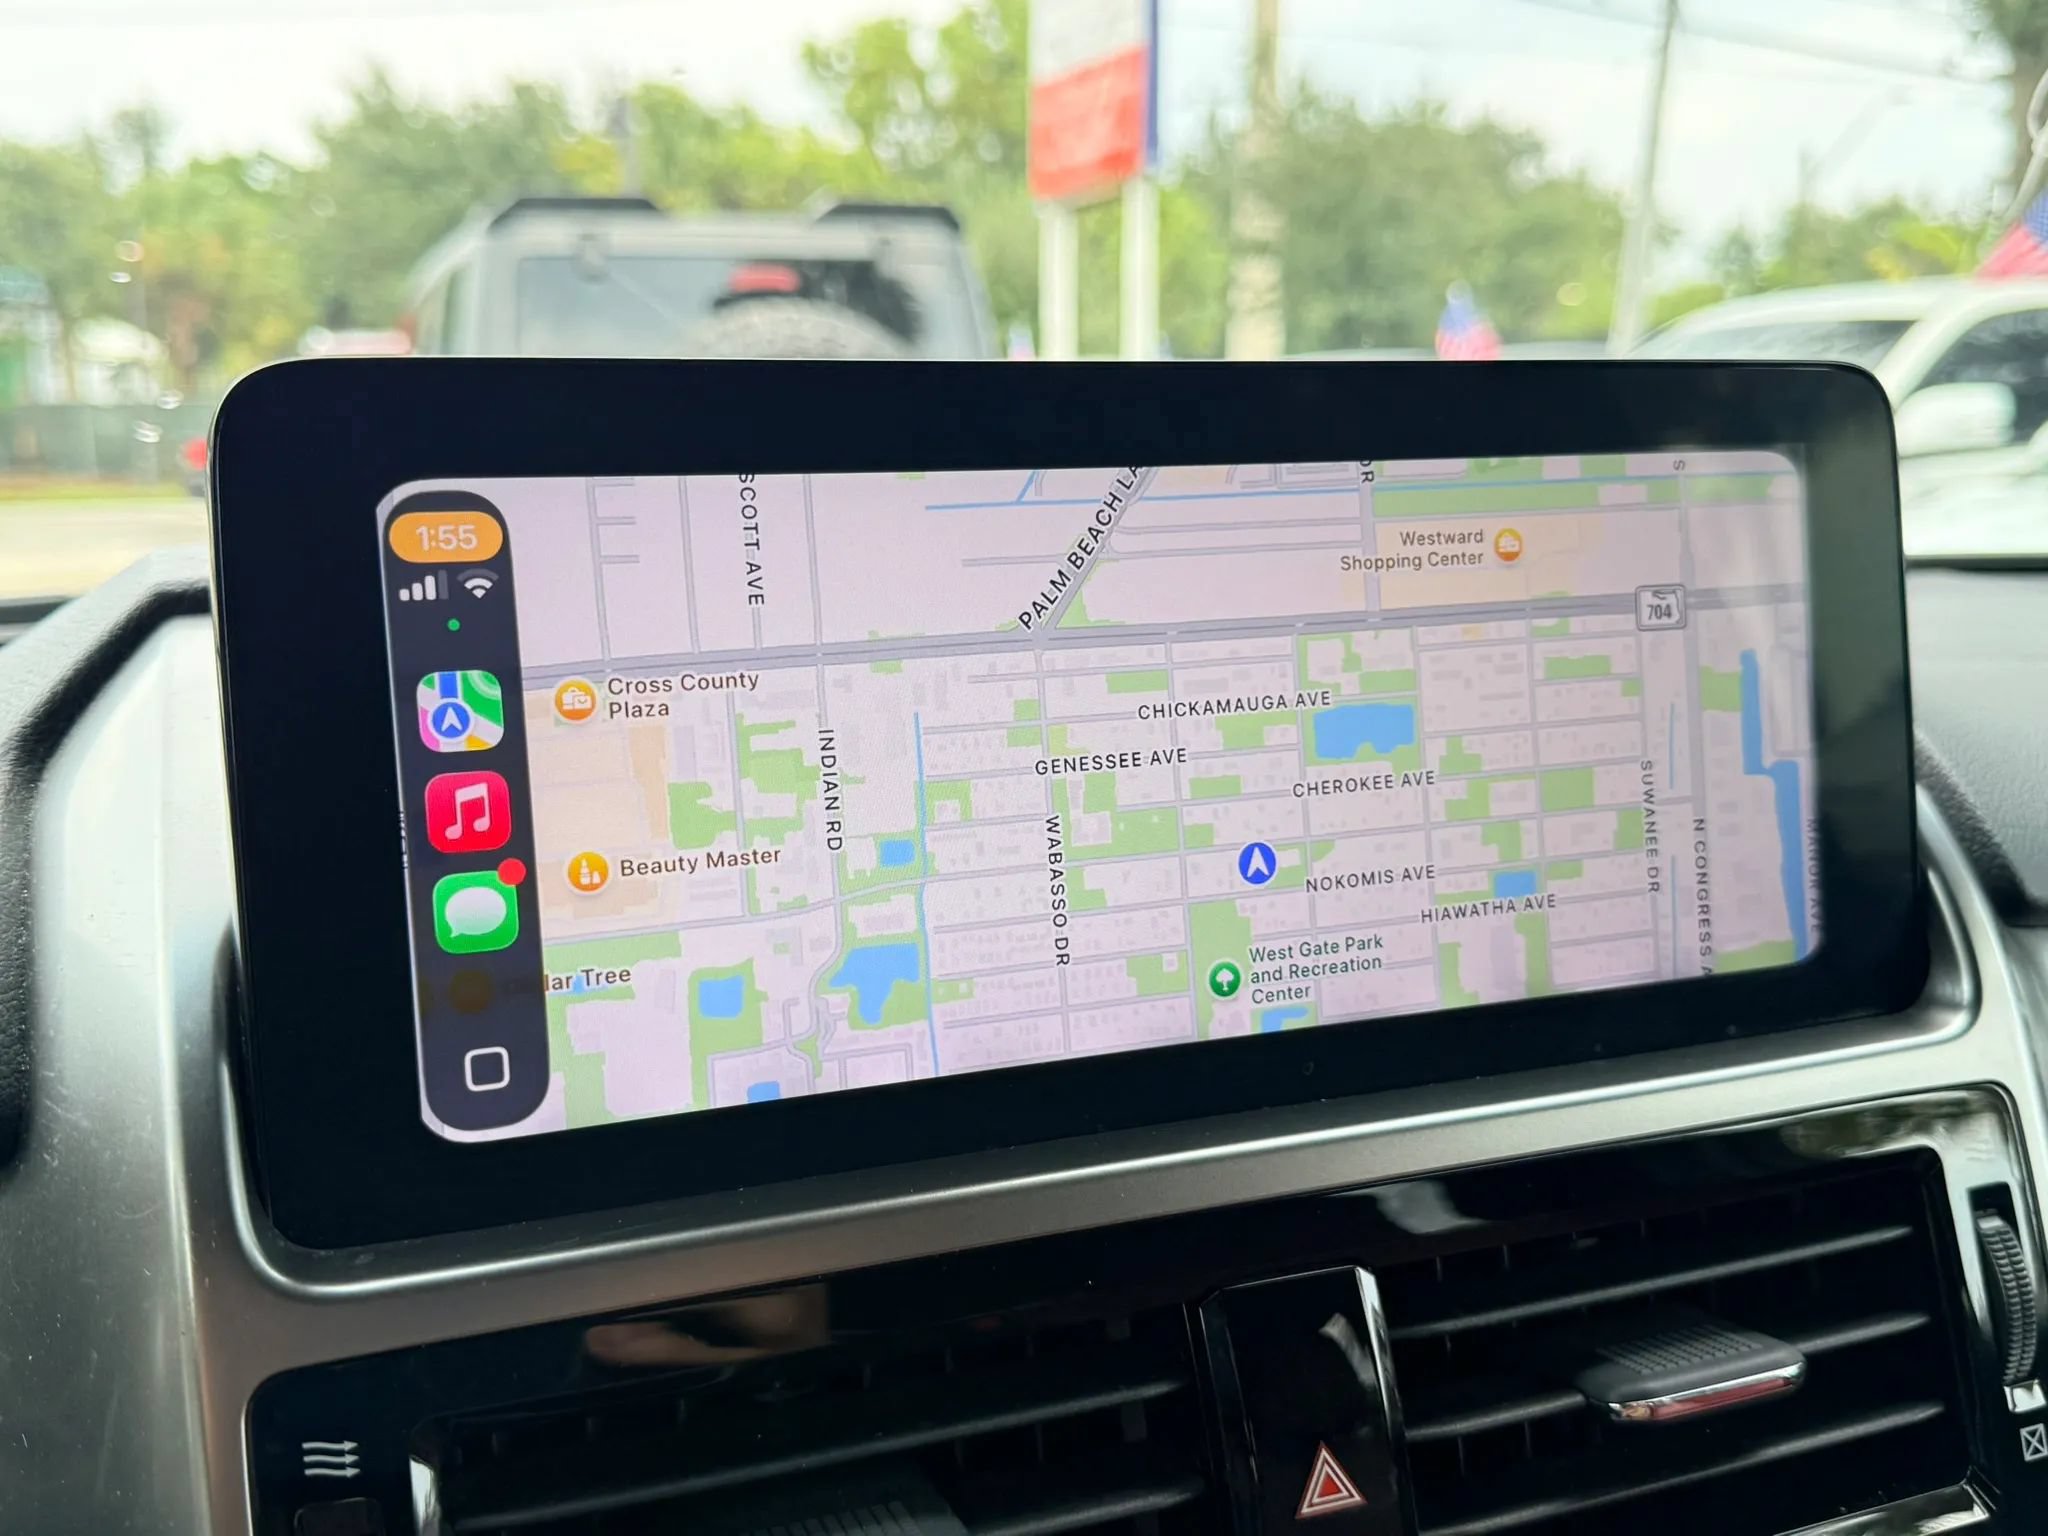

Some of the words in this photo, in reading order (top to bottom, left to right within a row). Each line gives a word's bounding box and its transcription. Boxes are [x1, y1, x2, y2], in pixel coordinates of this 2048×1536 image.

[739, 474, 760, 550] SCOTT
[416, 524, 478, 551] 1:55
[1400, 529, 1484, 548] Westward
[1018, 569, 1071, 630] PALM
[1067, 491, 1123, 570] BEACH
[1340, 552, 1422, 572] Shopping
[1427, 549, 1484, 568] Center
[745, 561, 764, 605] AVE
[1647, 603, 1672, 622] 704
[608, 675, 673, 695] Cross
[681, 671, 759, 692] County
[609, 700, 670, 719] Plaza
[1138, 694, 1288, 720] CHICKAMAUGA
[1298, 690, 1331, 708] AVE
[818, 729, 841, 811] INDIAN
[1034, 752, 1142, 776] GENESSEE
[1149, 748, 1187, 765] AVE
[1293, 774, 1394, 798] CHEROKEE
[1401, 770, 1435, 787] AVE
[1640, 760, 1658, 859] SUWANEE
[826, 820, 843, 851] RD
[1693, 818, 1705, 831] N
[620, 854, 698, 877] Beauty
[706, 847, 781, 868] Master
[1045, 815, 1067, 928] WABASSO
[1306, 869, 1394, 892] NOKOMIS
[1401, 865, 1435, 881] AVE
[1647, 866, 1661, 893] DR
[1421, 900, 1516, 924] HIAWATHA
[1524, 894, 1556, 910] AVE
[1694, 840, 1712, 957] CONGRESS
[1054, 937, 1070, 966] DR
[1249, 942, 1293, 963] West
[1299, 939, 1340, 958] Gate
[1345, 934, 1383, 953] Park
[581, 968, 631, 986] Tree
[1250, 966, 1282, 984] and
[1289, 956, 1382, 979] Recreation
[1251, 985, 1311, 1004] Center
